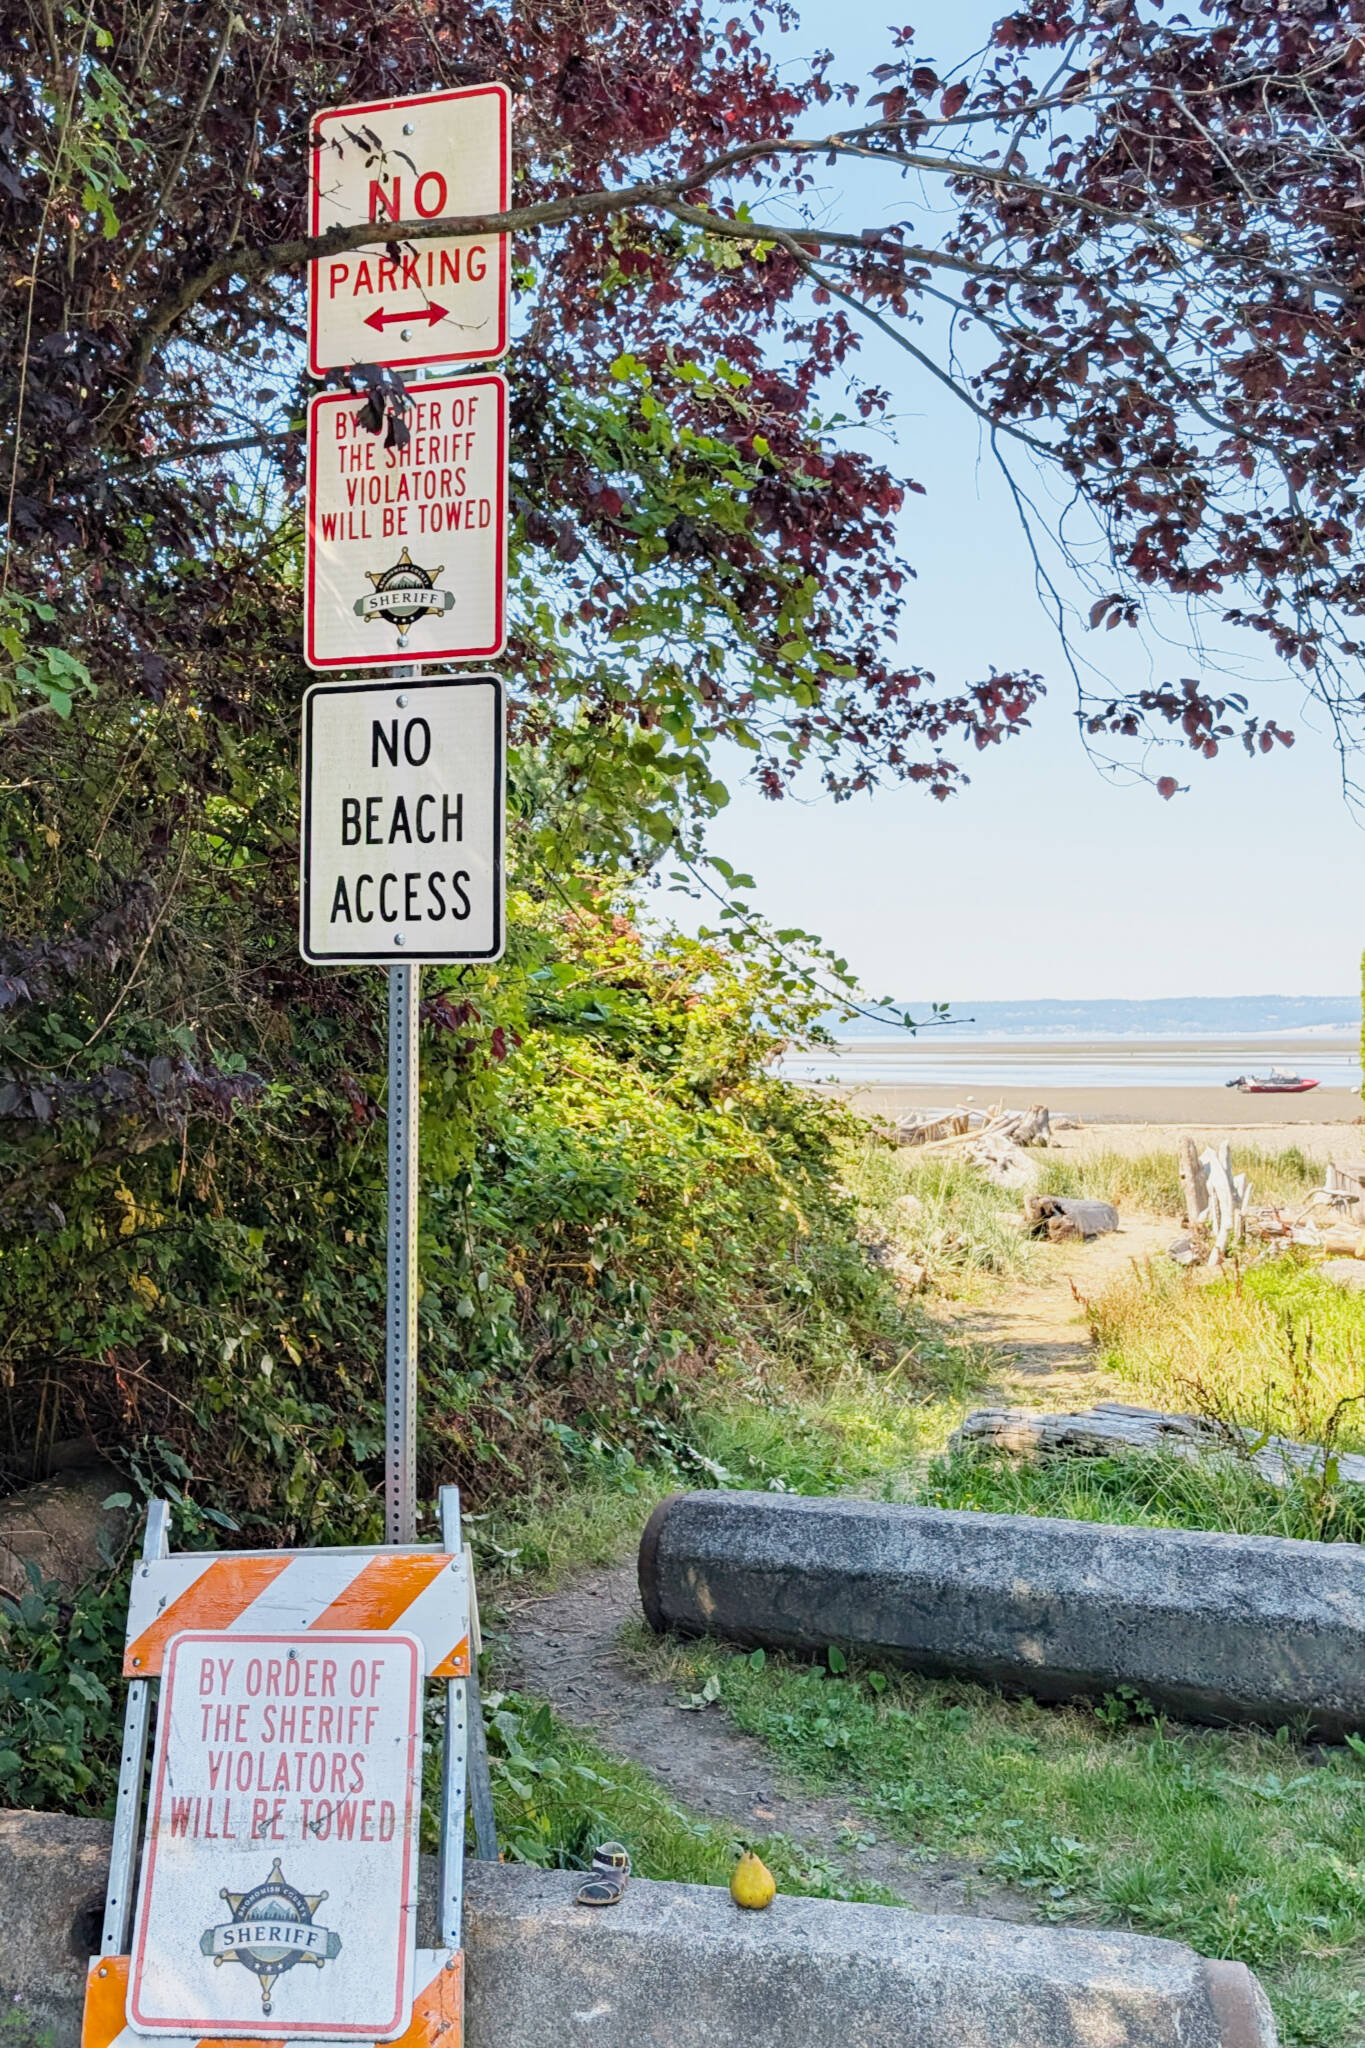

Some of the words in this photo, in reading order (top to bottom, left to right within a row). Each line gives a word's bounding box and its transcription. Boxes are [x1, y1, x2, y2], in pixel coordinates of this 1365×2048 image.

[369, 171, 448, 224] NO
[329, 246, 487, 299] PARKING
[335, 411, 361, 439] BY
[370, 402, 442, 436] DER
[452, 396, 479, 428] OF
[338, 442, 376, 473] THE
[384, 431, 476, 469] SHERIFF
[346, 467, 467, 507] VIOLATORS
[321, 510, 372, 542] WILL
[383, 506, 408, 538] BE
[418, 498, 491, 534] TOWED
[369, 592, 439, 609] SHERIFF
[371, 717, 431, 768] NO
[341, 793, 463, 846] BEACH
[329, 870, 471, 924] ACCESS
[199, 1658, 234, 1696] BY
[246, 1658, 337, 1697] ORDER
[350, 1659, 385, 1698] OF
[201, 1704, 250, 1742] THE
[261, 1704, 380, 1745] SHERIFF
[208, 1750, 365, 1794] VIOLATORS
[170, 1796, 236, 1838] WILL
[251, 1798, 287, 1841] BE
[300, 1799, 395, 1842] TOWED
[223, 1926, 318, 1948] SHERIFF
